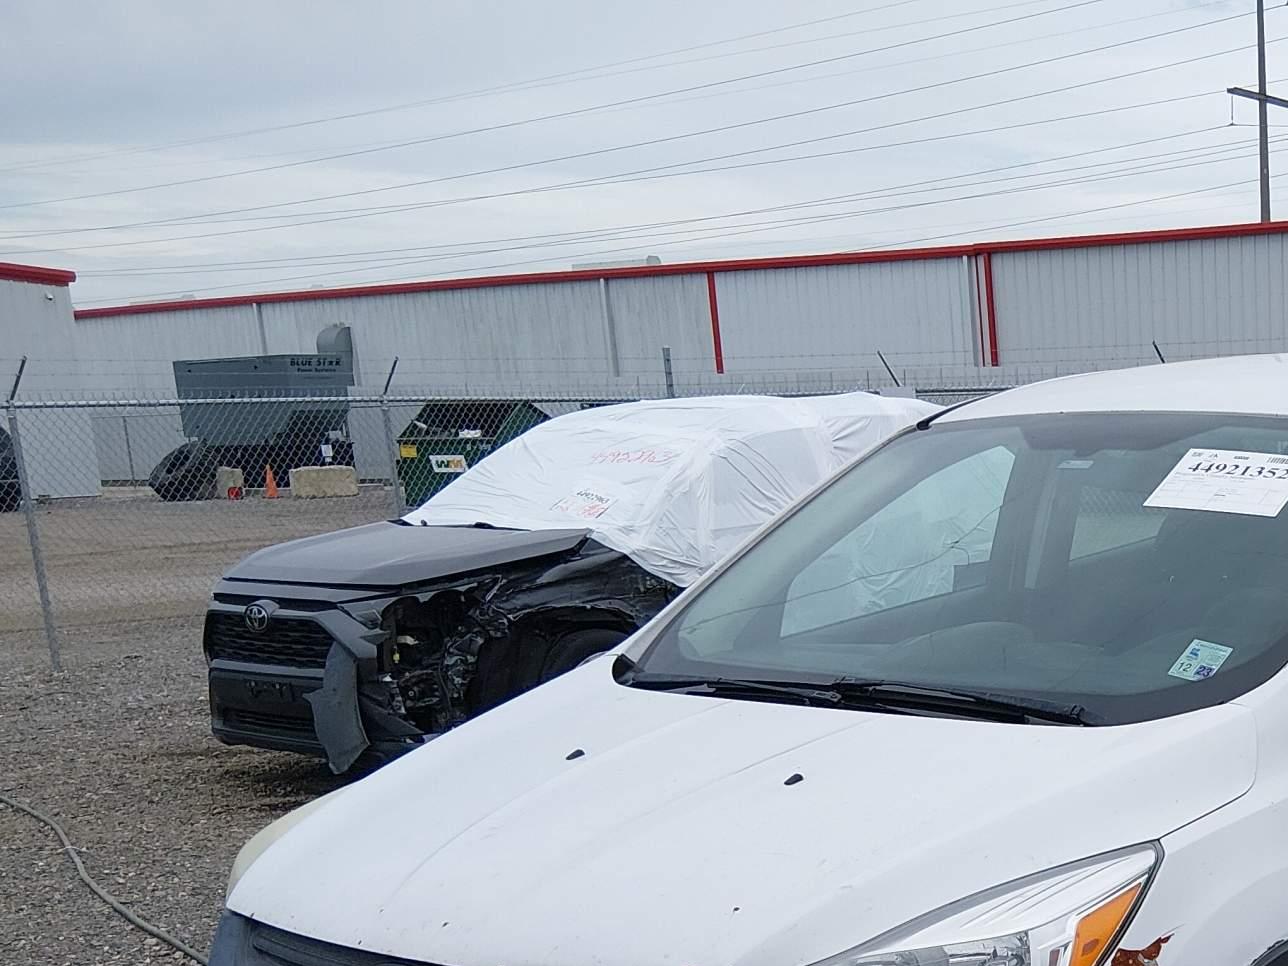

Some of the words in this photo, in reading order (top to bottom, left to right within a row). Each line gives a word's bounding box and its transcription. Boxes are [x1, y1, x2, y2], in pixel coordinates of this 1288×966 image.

[290, 358, 313, 366] BLUE
[1178, 661, 1193, 672] 12
[1198, 665, 1213, 677] 23
